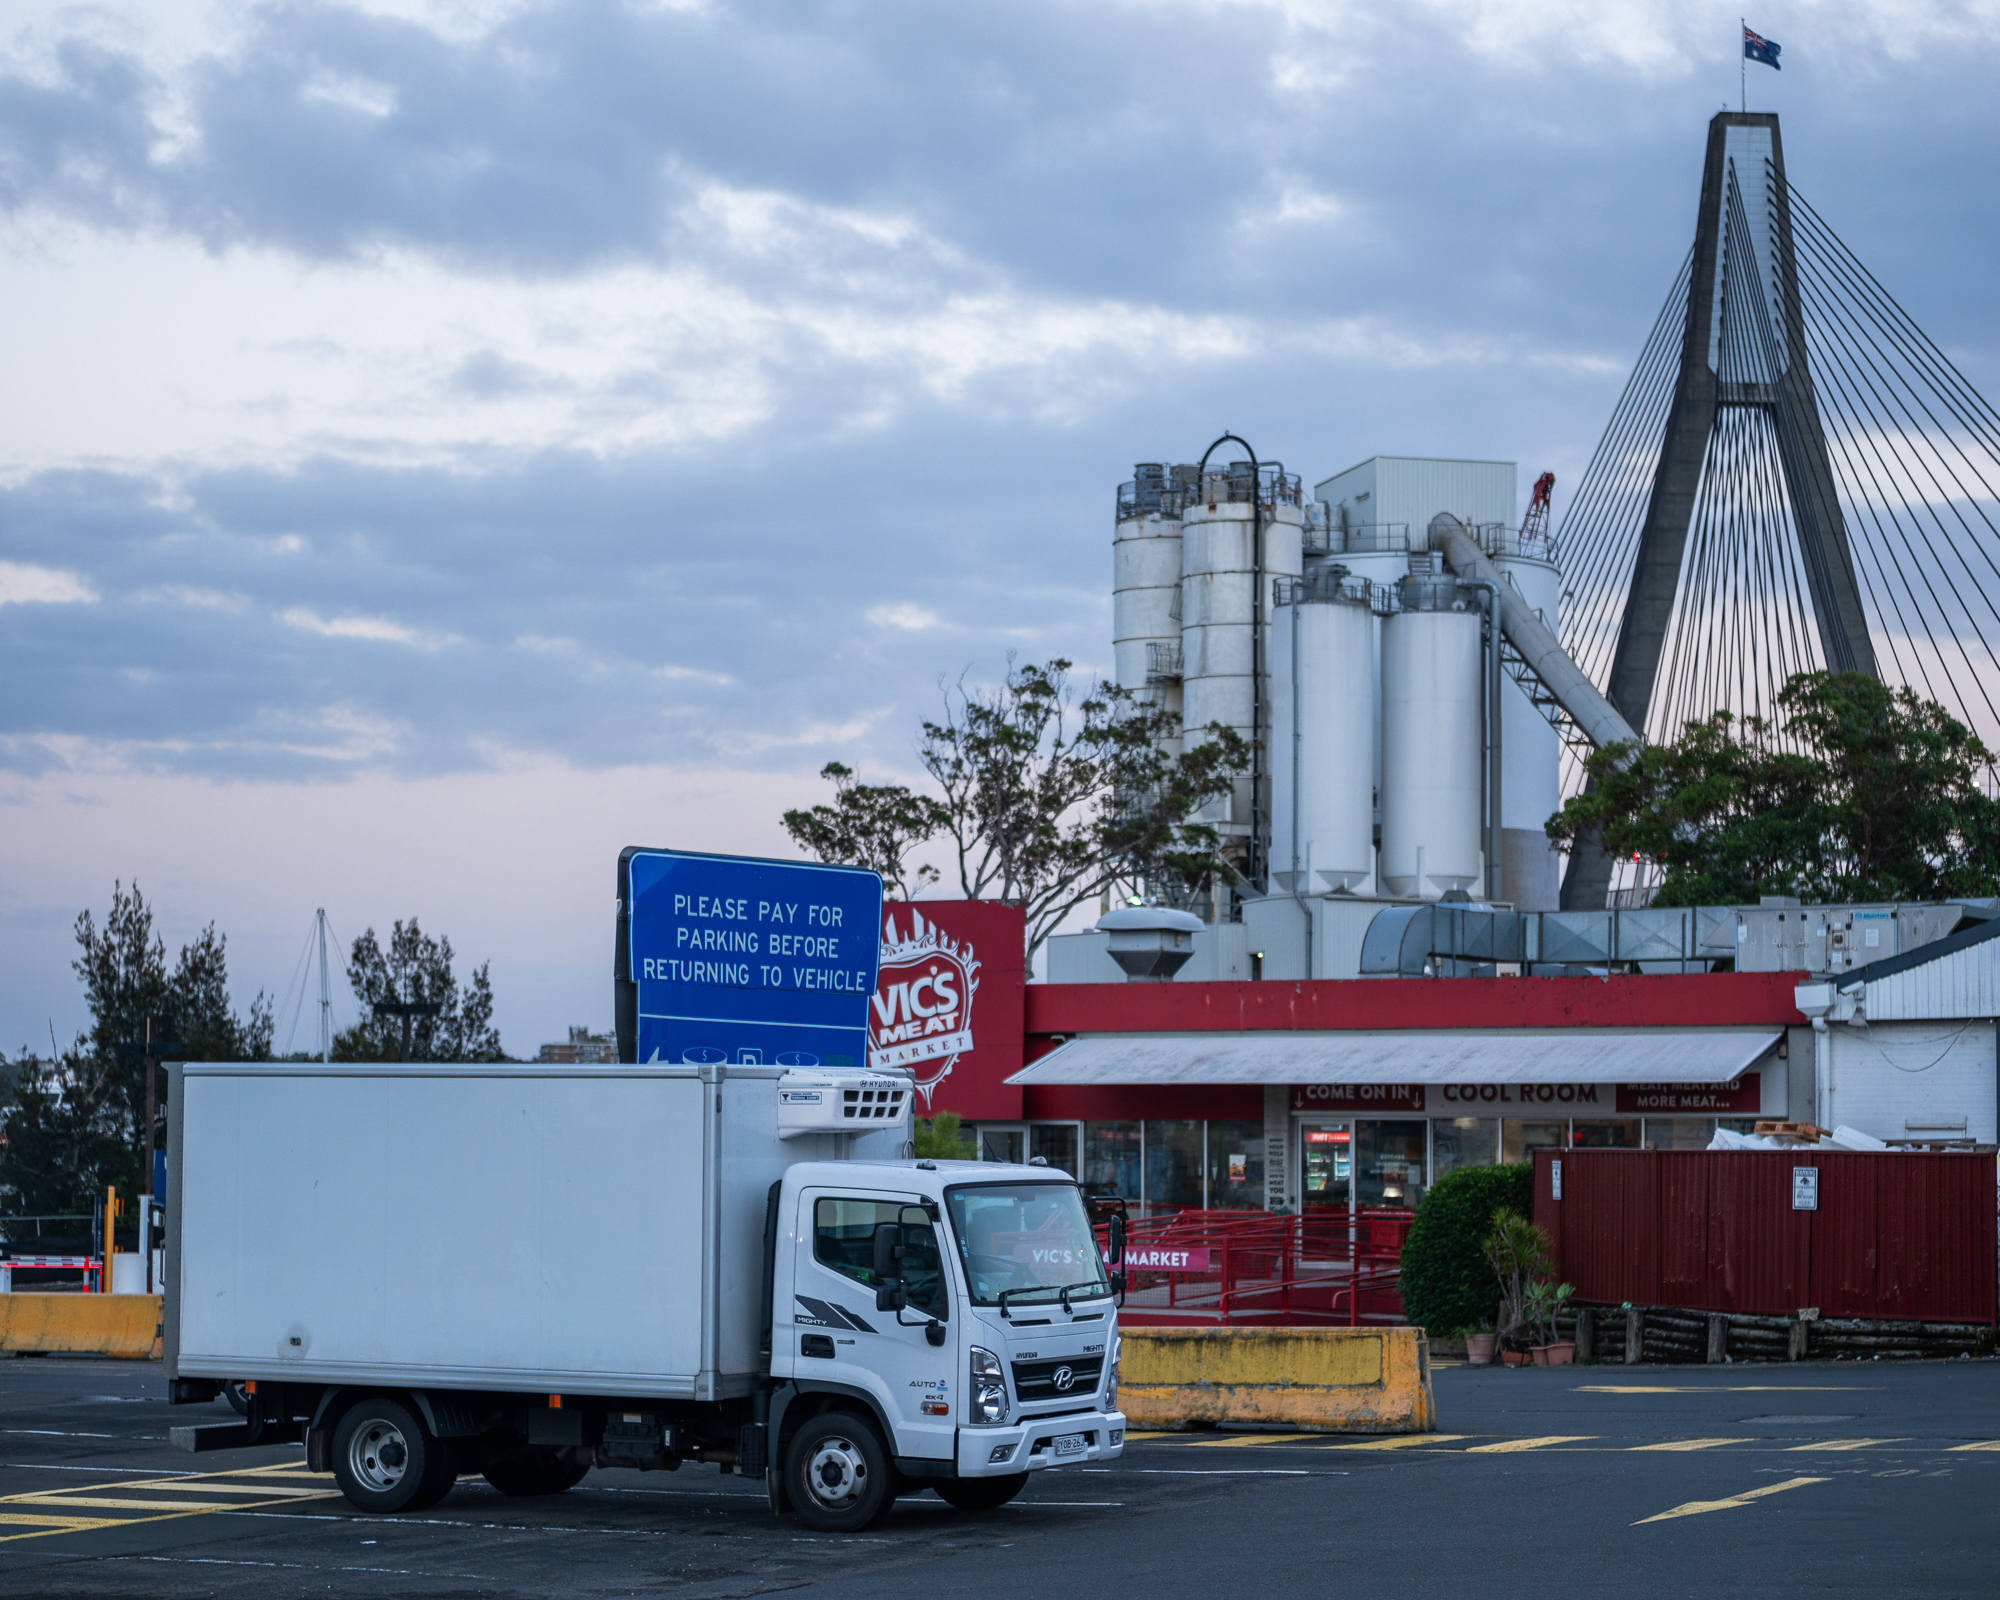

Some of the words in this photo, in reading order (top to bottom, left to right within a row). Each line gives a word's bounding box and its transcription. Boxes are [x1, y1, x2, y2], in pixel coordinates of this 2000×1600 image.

[674, 894, 748, 920] PLEASE
[759, 901, 798, 923] PAY
[808, 905, 843, 927] FOR
[677, 927, 759, 953] PARKING
[769, 933, 839, 958] BEFORE
[643, 957, 749, 985] RETURNING
[760, 965, 782, 987] TO
[793, 967, 867, 991] VEHICLE
[880, 1012, 960, 1046] MEAT
[880, 1037, 965, 1065] MARKET
[869, 1080, 898, 1088] HYUNDAI
[1306, 1085, 1355, 1099] COME
[1360, 1085, 1386, 1099] ON
[1392, 1085, 1410, 1099] IN
[1442, 1084, 1511, 1102] COOL
[1520, 1084, 1598, 1102] ROOM
[1637, 1096, 1676, 1107] MORE
[1032, 1250, 1073, 1264] VIC'S
[1126, 1252, 1189, 1267] MARKET
[797, 1316, 827, 1325] MIGHTY
[1083, 1344, 1105, 1352] MIGHTY
[909, 1380, 936, 1388] AUTO
